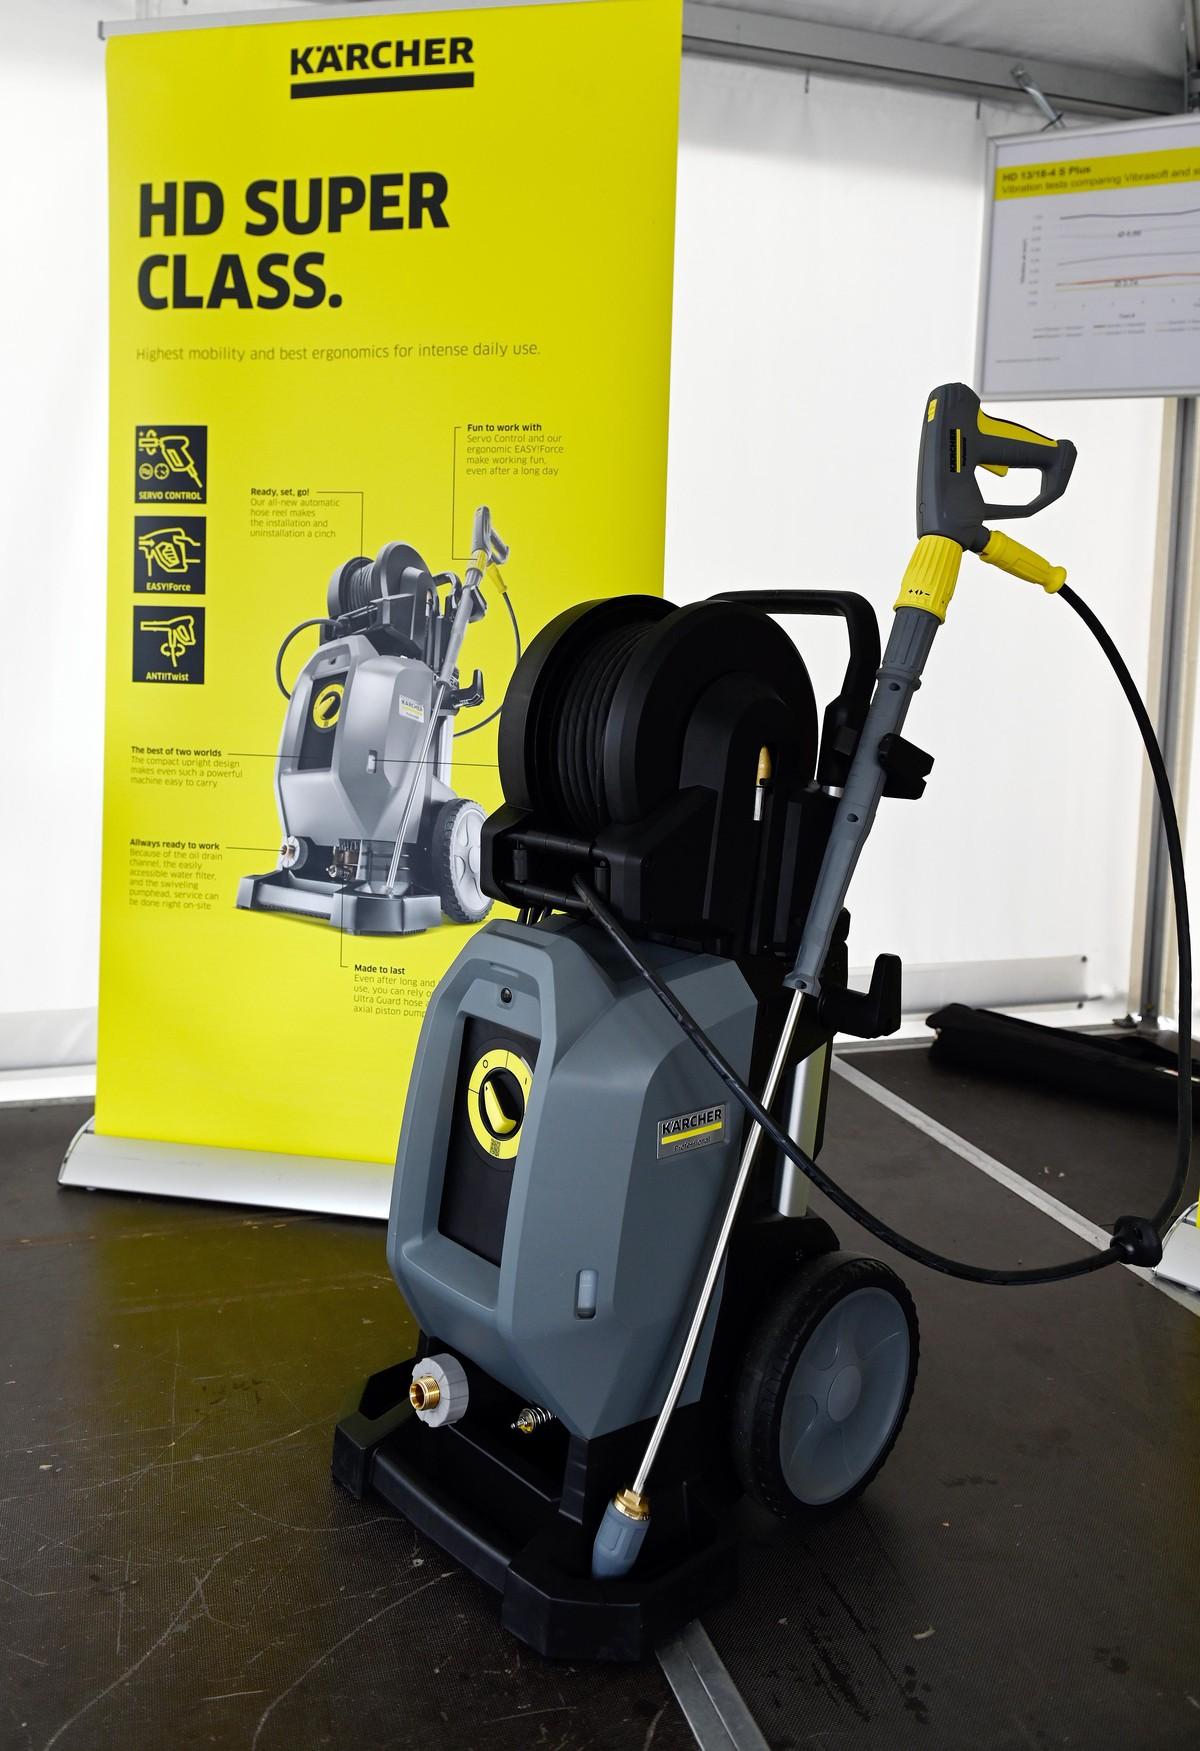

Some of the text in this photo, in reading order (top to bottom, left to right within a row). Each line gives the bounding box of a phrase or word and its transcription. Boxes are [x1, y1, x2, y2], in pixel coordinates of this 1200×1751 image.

[290, 37, 474, 75] KÄRCHER
[139, 171, 450, 238] HD SUPER
[137, 252, 342, 311] CLASS.
[136, 342, 540, 362] Highest mobility and best ergonomics for intense daily use.
[467, 434, 562, 443] Servo Control and our
[466, 446, 511, 454] ergonomic
[466, 456, 489, 464] make
[492, 456, 527, 465] working
[466, 467, 487, 475] even
[489, 466, 510, 475] after
[521, 466, 540, 476] long
[542, 466, 559, 476] day
[139, 491, 202, 500] SERVO CONTROL
[250, 498, 265, 506] Our
[300, 499, 340, 507] automatic
[250, 509, 316, 517] hose reel makes
[250, 519, 328, 528] the installation and
[314, 530, 336, 538] cinch
[131, 746, 222, 757] The best of two worlds
[146, 758, 180, 766] compact
[182, 758, 211, 768] upright
[213, 759, 240, 769] design
[156, 768, 177, 776] even
[178, 768, 197, 777] such
[207, 769, 243, 779] powerful
[164, 778, 184, 787] easy
[185, 778, 194, 786] to
[196, 779, 218, 788] carry
[162, 840, 186, 850] ready
[188, 841, 196, 849] to
[198, 842, 220, 850] work
[354, 964, 405, 974] Made to last
[354, 974, 436, 987] Even after long and
[372, 986, 388, 995] you
[390, 987, 405, 995] can
[407, 988, 424, 998] rely
[376, 996, 401, 1005] Guard
[403, 998, 423, 1007] hose
[353, 1004, 373, 1013] axial
[375, 1006, 400, 1015] piston
